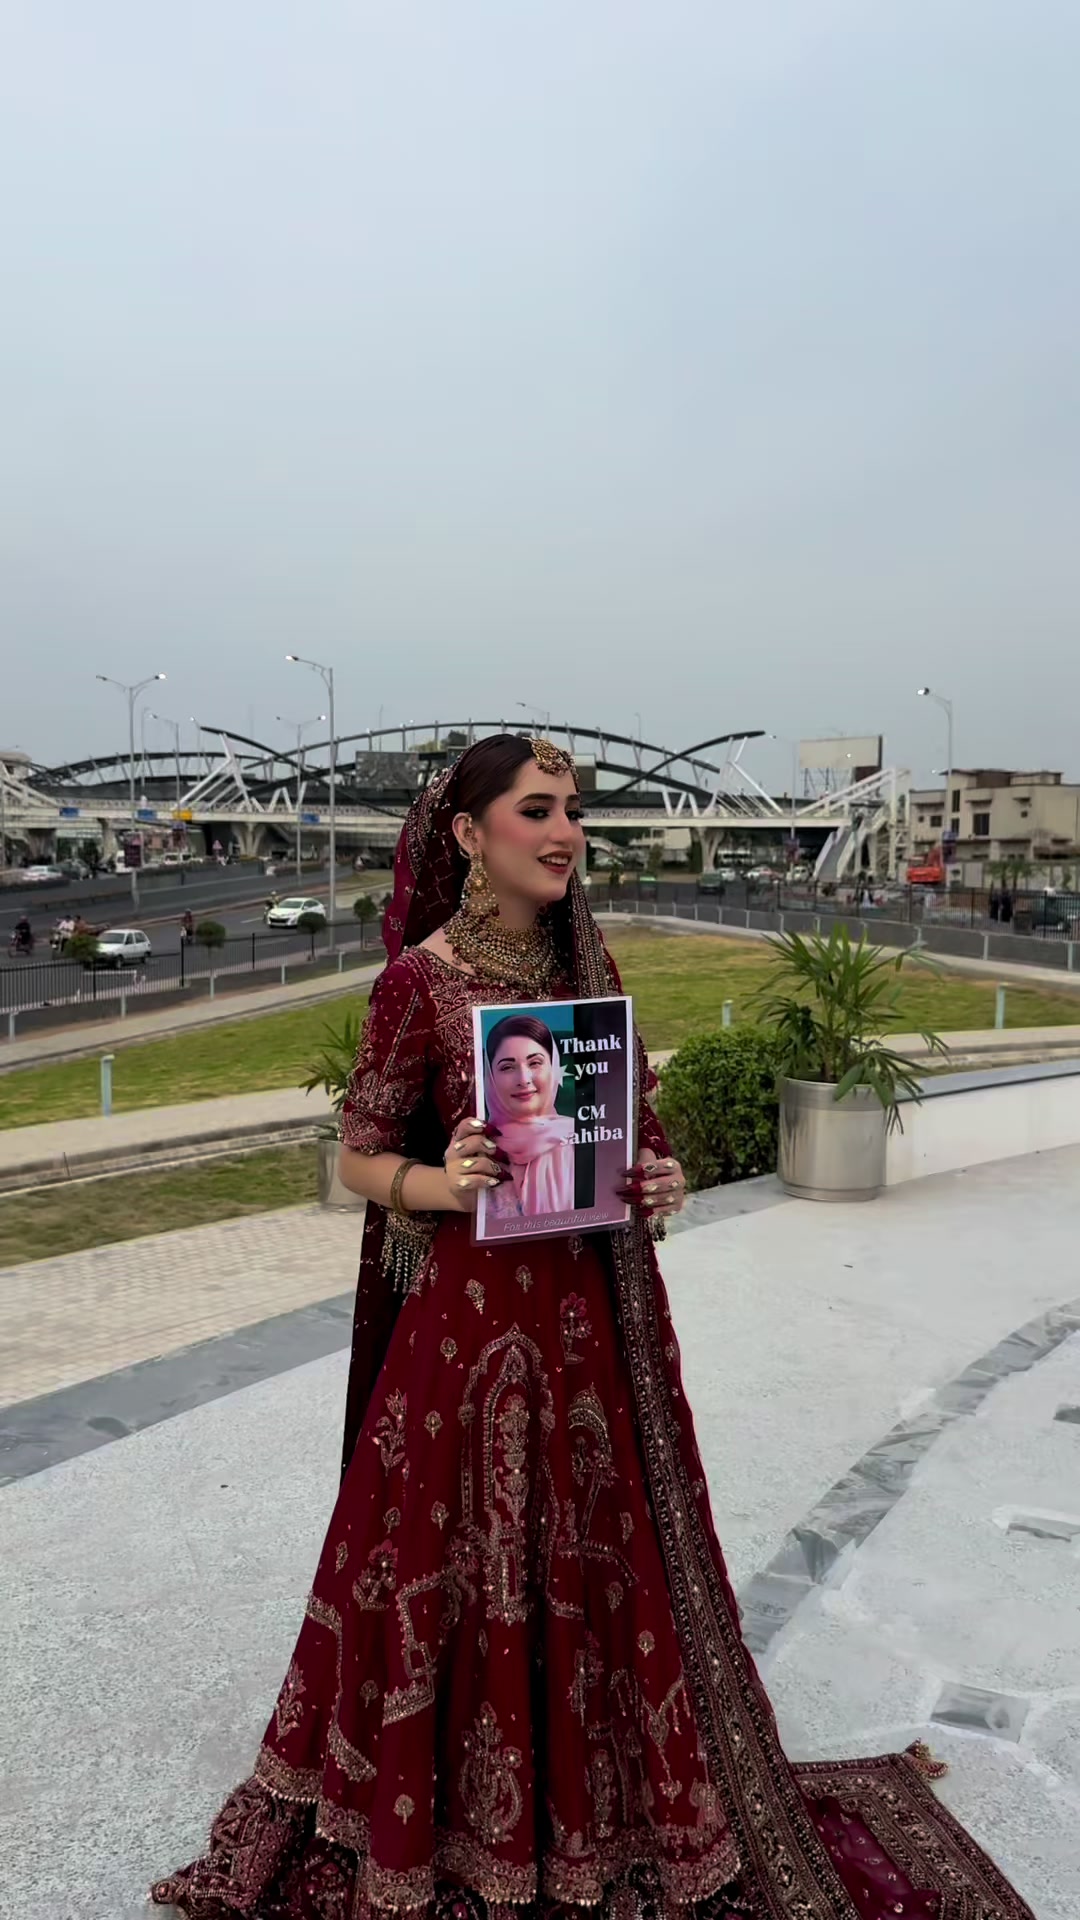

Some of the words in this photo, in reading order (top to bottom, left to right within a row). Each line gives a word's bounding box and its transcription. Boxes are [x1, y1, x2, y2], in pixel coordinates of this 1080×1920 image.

[560, 1034, 622, 1054] Thank
[574, 1061, 608, 1080] you
[577, 1104, 606, 1121] CM
[523, 1220, 541, 1230] this
